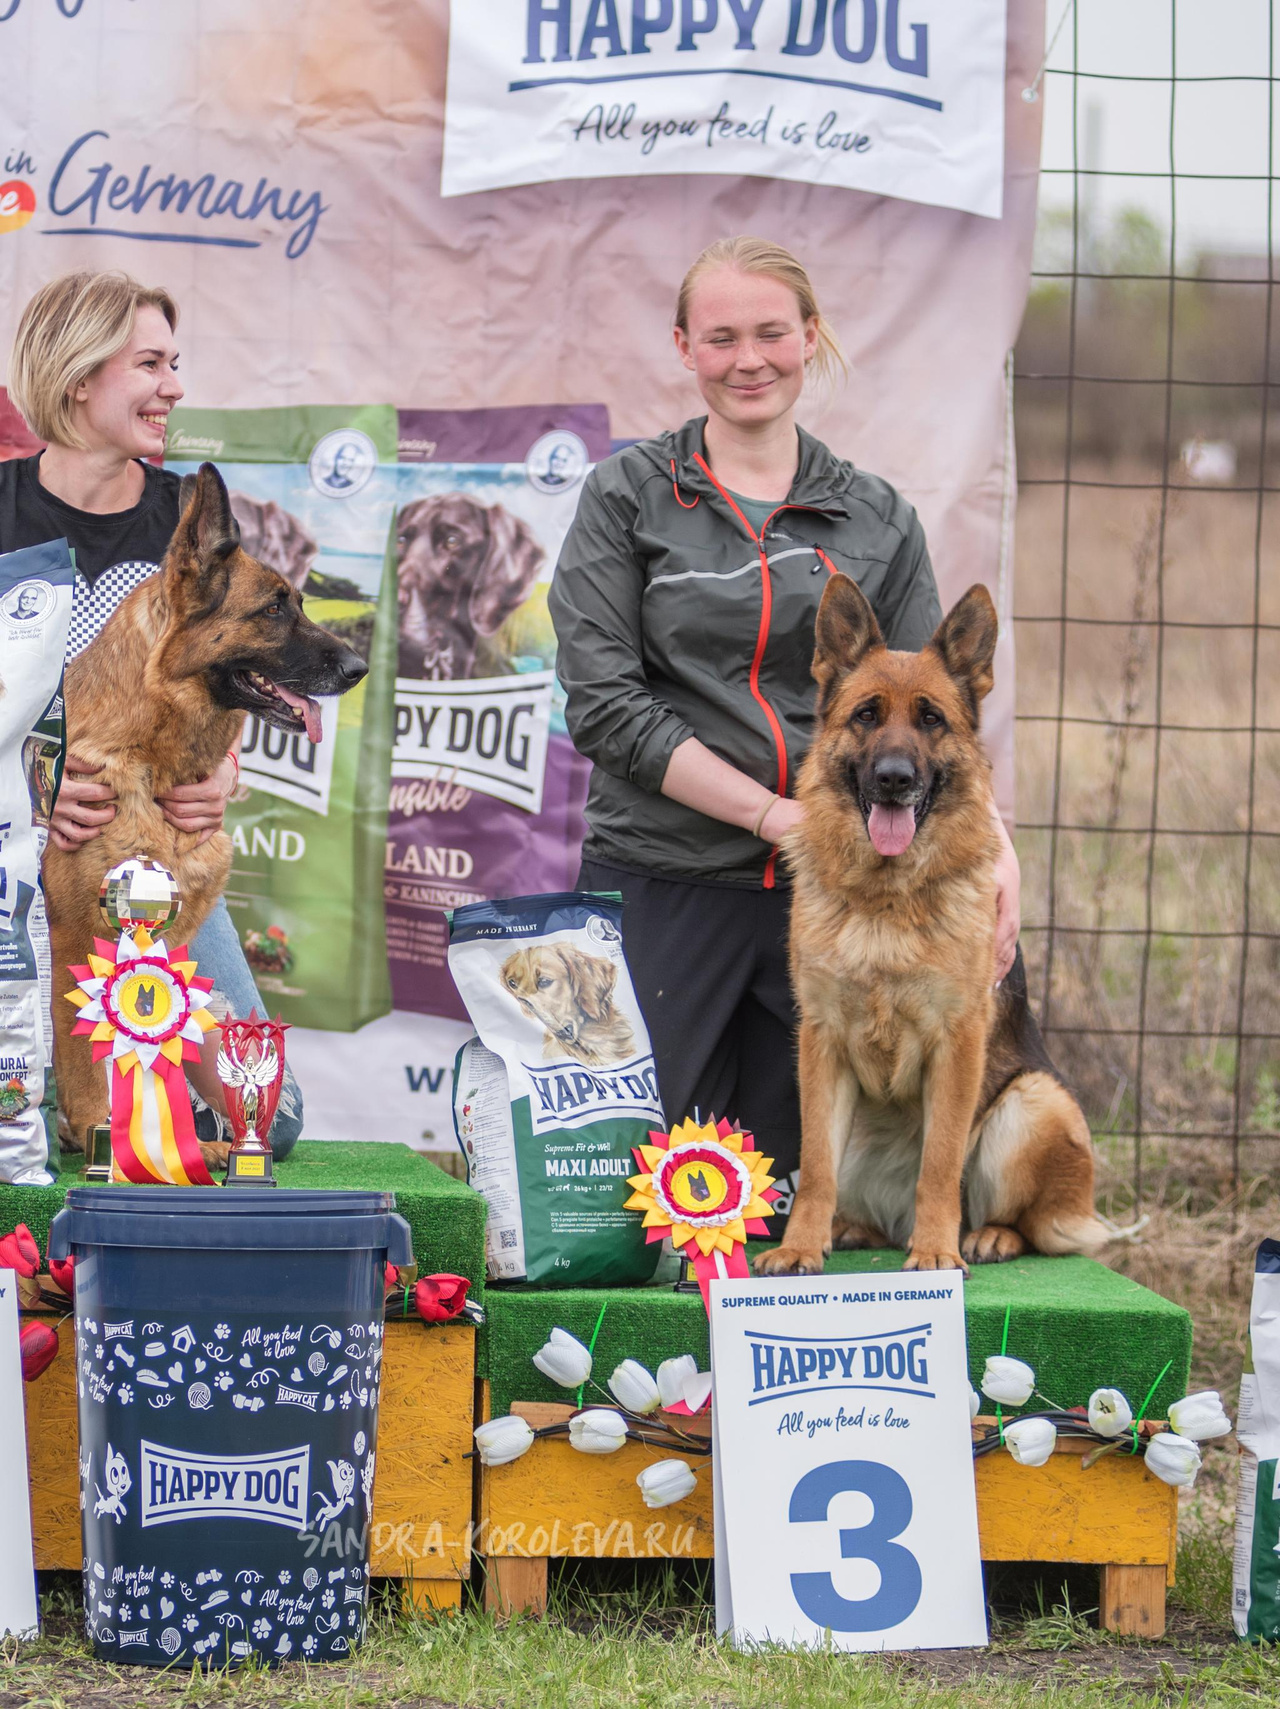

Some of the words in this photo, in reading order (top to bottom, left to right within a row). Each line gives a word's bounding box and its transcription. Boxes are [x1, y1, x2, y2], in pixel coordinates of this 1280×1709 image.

[522, 0, 754, 63] HAPPY
[781, 0, 928, 78] DOG
[573, 104, 630, 143] All
[642, 116, 700, 155] you
[702, 102, 768, 147] feed
[781, 118, 809, 142] is
[817, 112, 873, 155] love
[4, 148, 37, 175] in
[48, 130, 331, 258] Germany
[167, 429, 224, 454] Germany
[446, 704, 535, 771] DOG
[476, 927, 502, 935] MADE
[622, 1066, 660, 1103] DO
[544, 1143, 574, 1155] Supreme
[575, 1143, 586, 1152] Fit
[587, 1143, 596, 1153] &
[596, 1142, 611, 1151] Well
[546, 1159, 586, 1177] MAXI
[590, 1158, 631, 1176] ADULT
[599, 1184, 613, 1192] 23/12
[504, 1261, 515, 1271] kg
[554, 1257, 560, 1267] 4
[560, 1258, 570, 1268] kg
[721, 1296, 775, 1308] SUPREME
[778, 1293, 828, 1306] QUALITY
[842, 1292, 876, 1303] MADE
[878, 1291, 891, 1302] IN
[894, 1289, 953, 1301] GERMANY
[121, 1323, 133, 1335] CAT
[241, 1326, 261, 1347] All
[263, 1331, 281, 1345] you
[281, 1325, 303, 1342] feed
[264, 1346, 273, 1357] is
[274, 1344, 296, 1359] love
[750, 1342, 858, 1393] HAPPY
[863, 1337, 928, 1385] DOG
[277, 1388, 301, 1405] HAPPY
[301, 1394, 318, 1408] CAT
[777, 1411, 803, 1435] All
[807, 1417, 833, 1438] you
[835, 1406, 866, 1431] feed
[868, 1413, 881, 1426] is
[884, 1407, 910, 1429] love
[149, 1459, 239, 1507] HAPPY
[244, 1464, 300, 1509] DOG
[788, 1459, 923, 1633] 3
[112, 1565, 124, 1584] All
[125, 1571, 138, 1586] you
[138, 1564, 156, 1583] feed
[133, 1580, 150, 1598] love
[259, 1589, 277, 1607] All
[277, 1595, 295, 1610] you
[294, 1594, 315, 1613] feed
[277, 1611, 285, 1622] is
[286, 1608, 306, 1626] love
[135, 1631, 147, 1643] CAT
